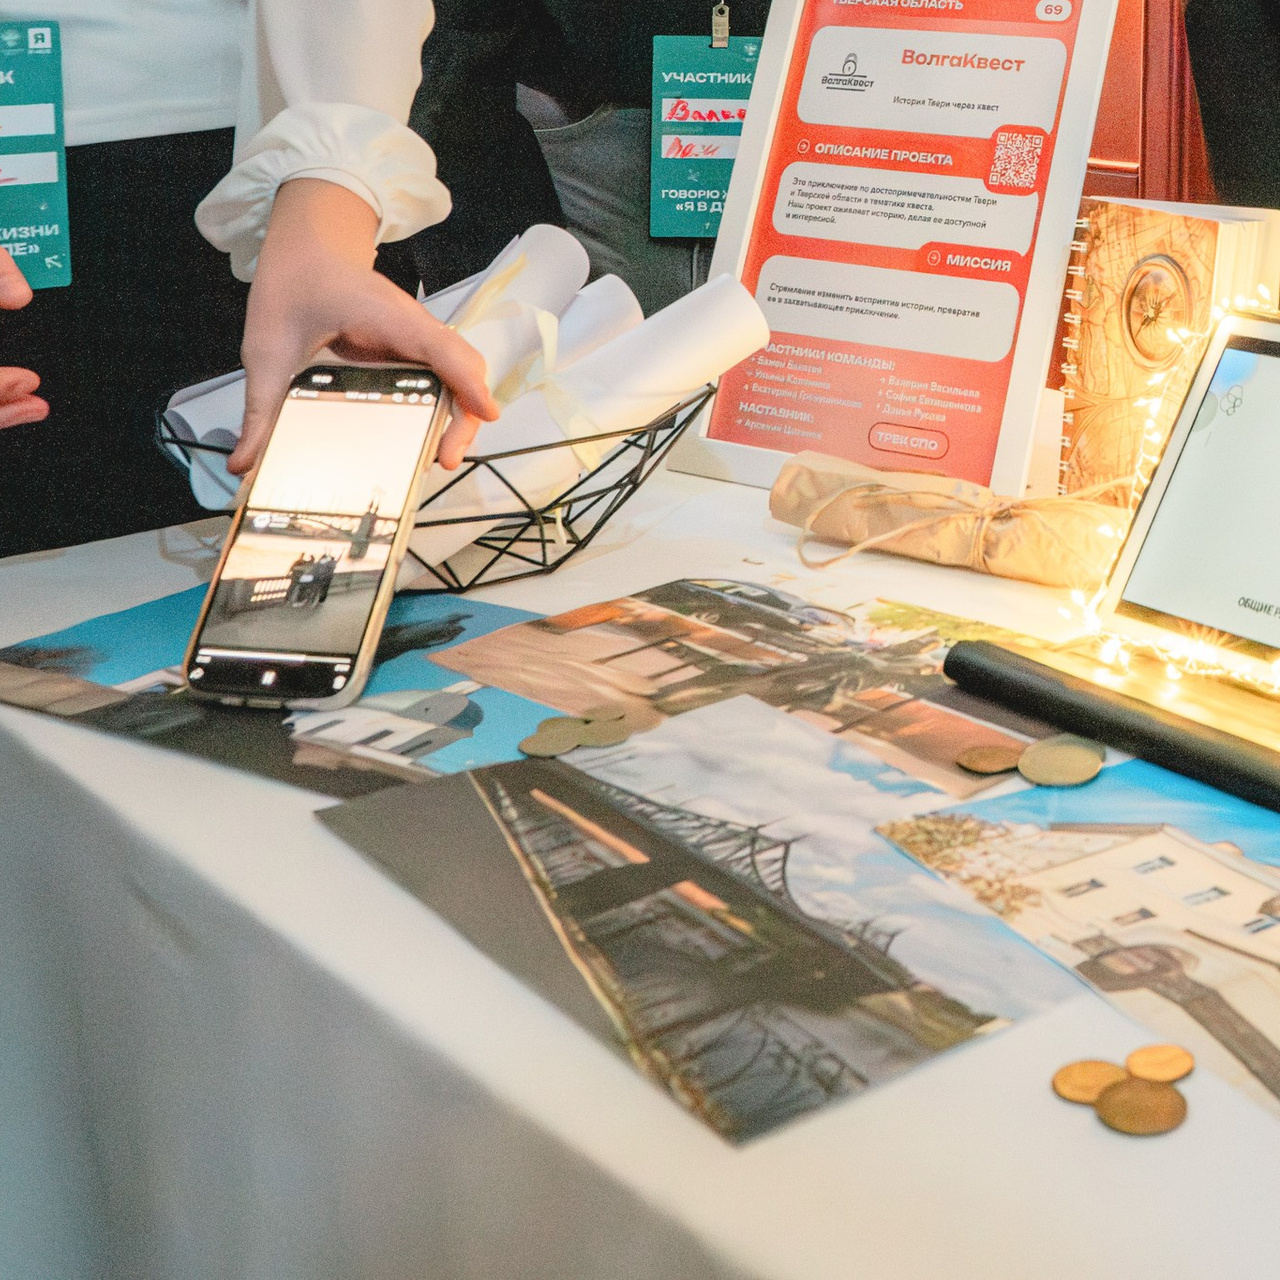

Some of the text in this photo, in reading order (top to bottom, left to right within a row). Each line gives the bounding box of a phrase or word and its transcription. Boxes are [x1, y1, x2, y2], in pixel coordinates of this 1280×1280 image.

[1044, 4, 1063, 16] 69
[901, 49, 1026, 73] ВолгаКвест
[661, 72, 752, 84] УЧАСТНИК
[820, 75, 874, 89] ВолгаКвест
[892, 95, 999, 113] История Твери через квест
[815, 143, 953, 166] ОПИСАНИЕ ПРОЕКТА
[661, 189, 720, 199] ГОВОРЮ
[797, 189, 831, 201] Тверской
[831, 192, 862, 204] области
[870, 198, 905, 209] тематике
[807, 180, 858, 192] приключение
[860, 185, 868, 193] по
[870, 187, 972, 203] достопримечательностям
[974, 195, 998, 207] Твери
[697, 202, 707, 211] В
[787, 200, 804, 209] Наш
[805, 202, 832, 213] проект
[833, 206, 870, 216] оживляет
[871, 209, 907, 221] историю,
[908, 214, 932, 223] делая
[944, 217, 987, 229] доступной
[791, 213, 837, 224] интересной.
[946, 253, 1012, 272] МИССИЯ
[769, 282, 981, 319] Стремление изменить восприятие истории, превратив
[764, 343, 825, 360] АСТНИКИ
[827, 351, 896, 370] КОМАНДЫ:
[876, 431, 939, 451] ТРЕК СПО
[1237, 596, 1275, 616] ОБЩИЕ
